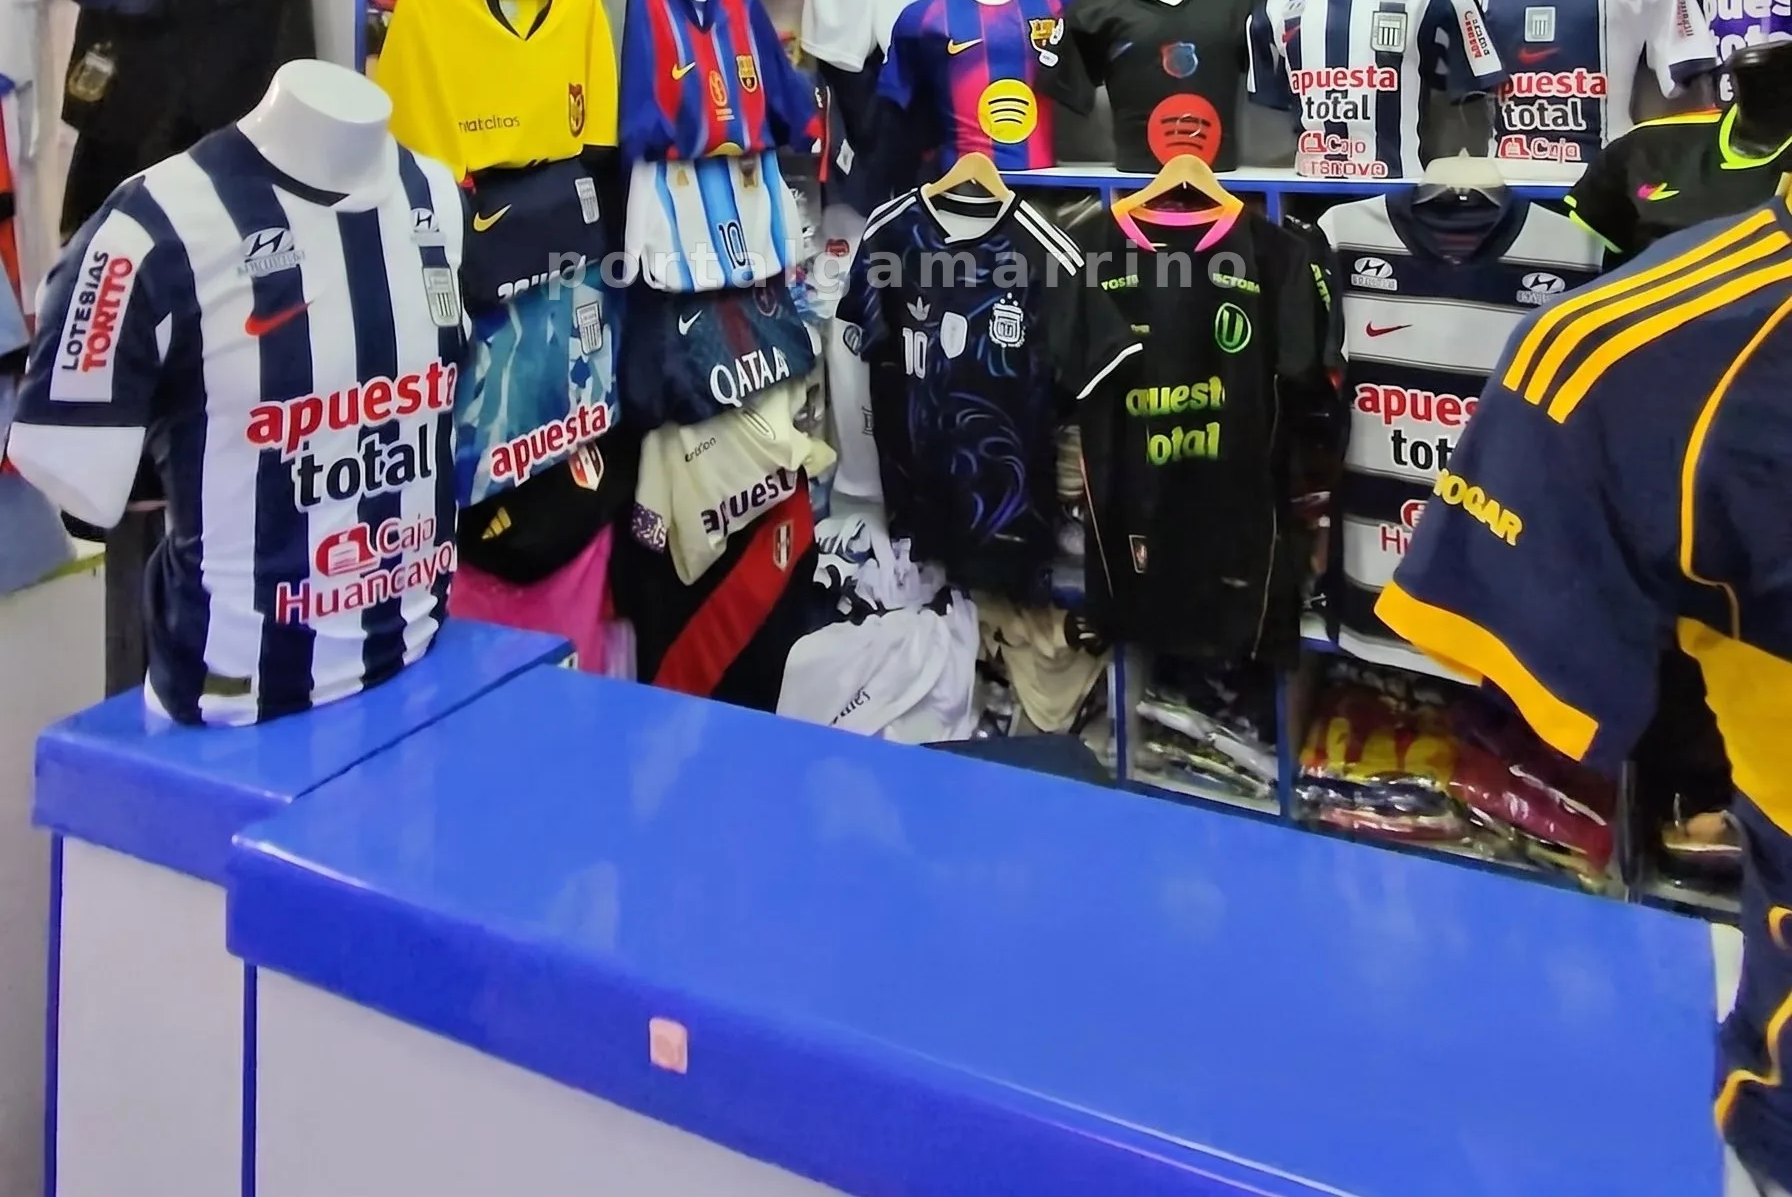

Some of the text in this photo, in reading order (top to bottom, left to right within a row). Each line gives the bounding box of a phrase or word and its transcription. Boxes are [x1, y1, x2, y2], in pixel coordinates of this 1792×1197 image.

[1291, 66, 1396, 96] apuesta
[1306, 95, 1371, 120] total
[1505, 101, 1582, 128] total
[718, 221, 748, 270] 10
[903, 327, 928, 379] 10
[297, 423, 432, 507] total
[492, 405, 606, 481] apuesta
[276, 543, 453, 624] Huancayo
